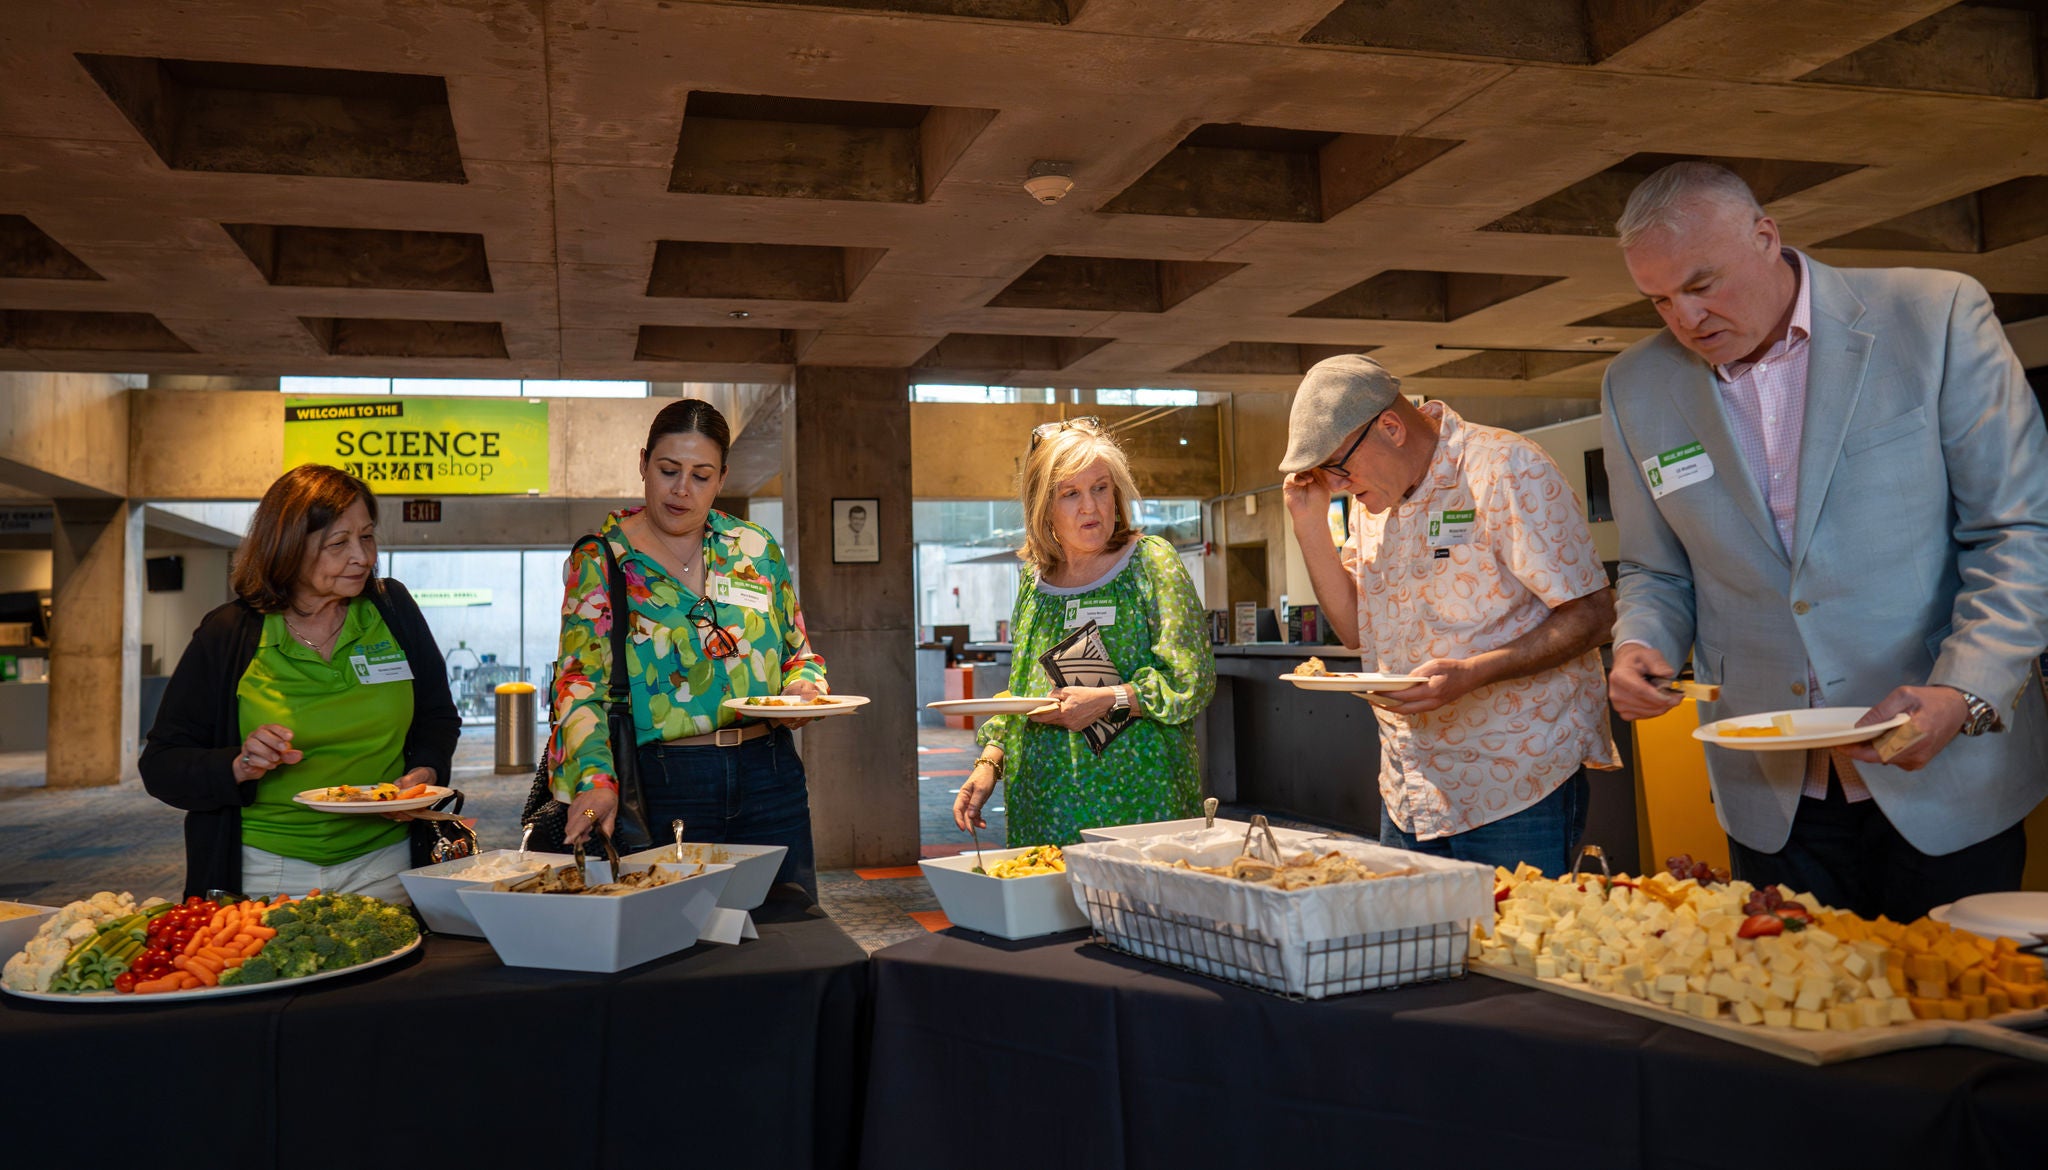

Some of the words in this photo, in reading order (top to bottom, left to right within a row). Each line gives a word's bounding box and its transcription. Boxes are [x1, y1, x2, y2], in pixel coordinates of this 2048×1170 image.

[297, 406, 356, 420] WELCOME
[357, 405, 374, 417] TO
[376, 404, 398, 416] THE
[336, 430, 500, 457] SCIENCE
[438, 455, 493, 481] shop
[409, 503, 436, 521] EXIT
